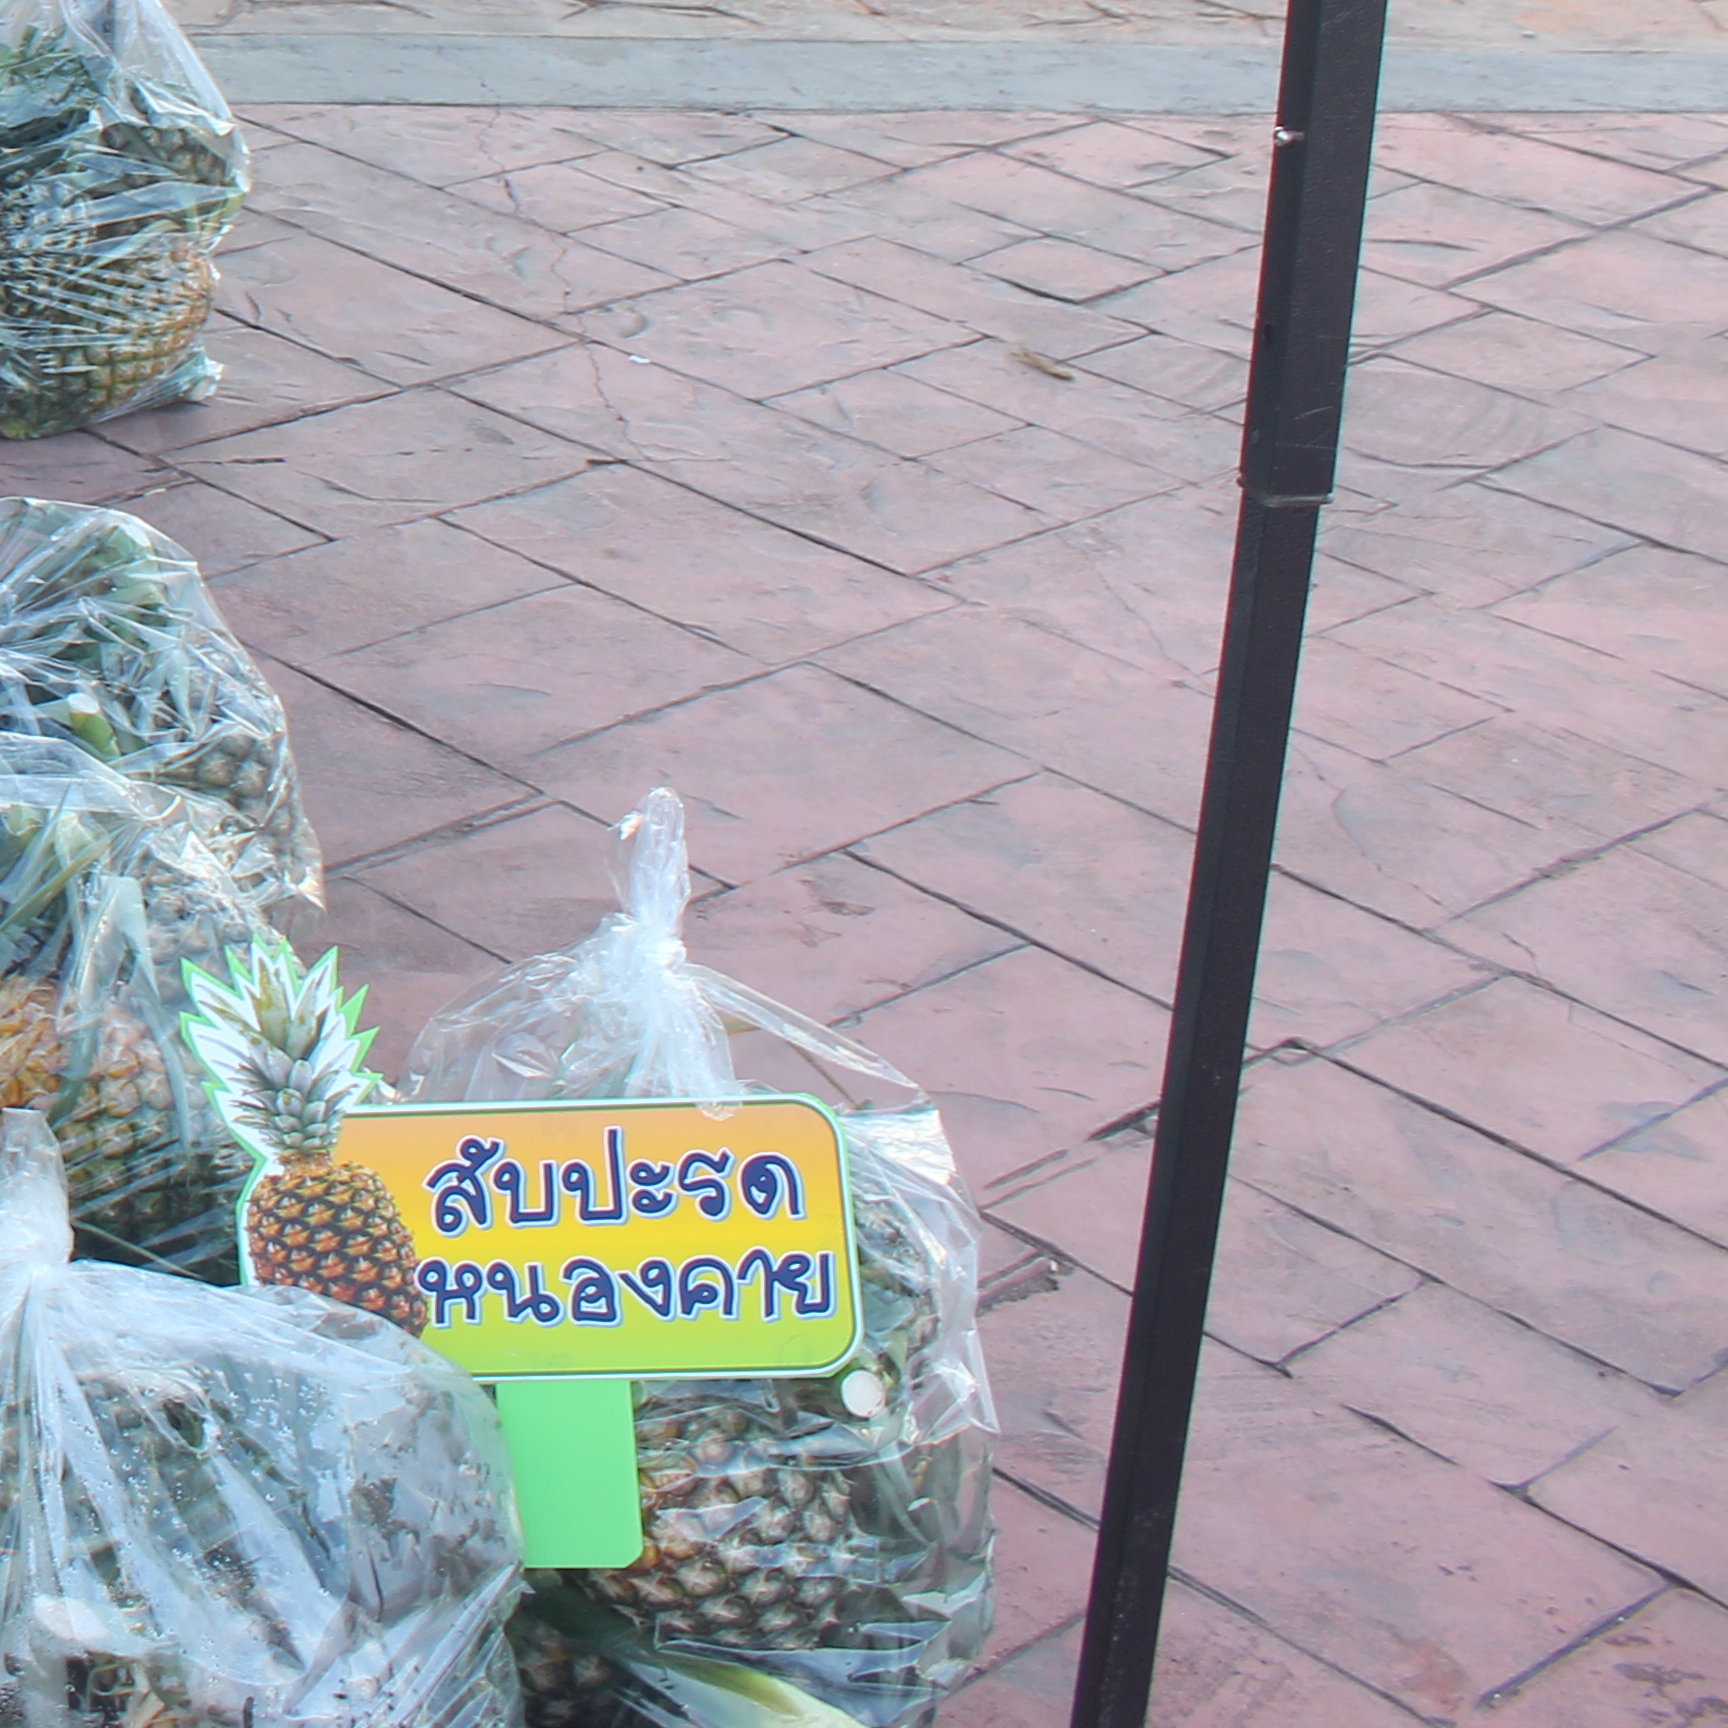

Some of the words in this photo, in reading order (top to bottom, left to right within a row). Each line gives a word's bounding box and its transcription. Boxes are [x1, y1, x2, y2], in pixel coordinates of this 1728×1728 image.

[426, 1126, 805, 1233] สับปะรด
[415, 1248, 834, 1325] หนองคาย
